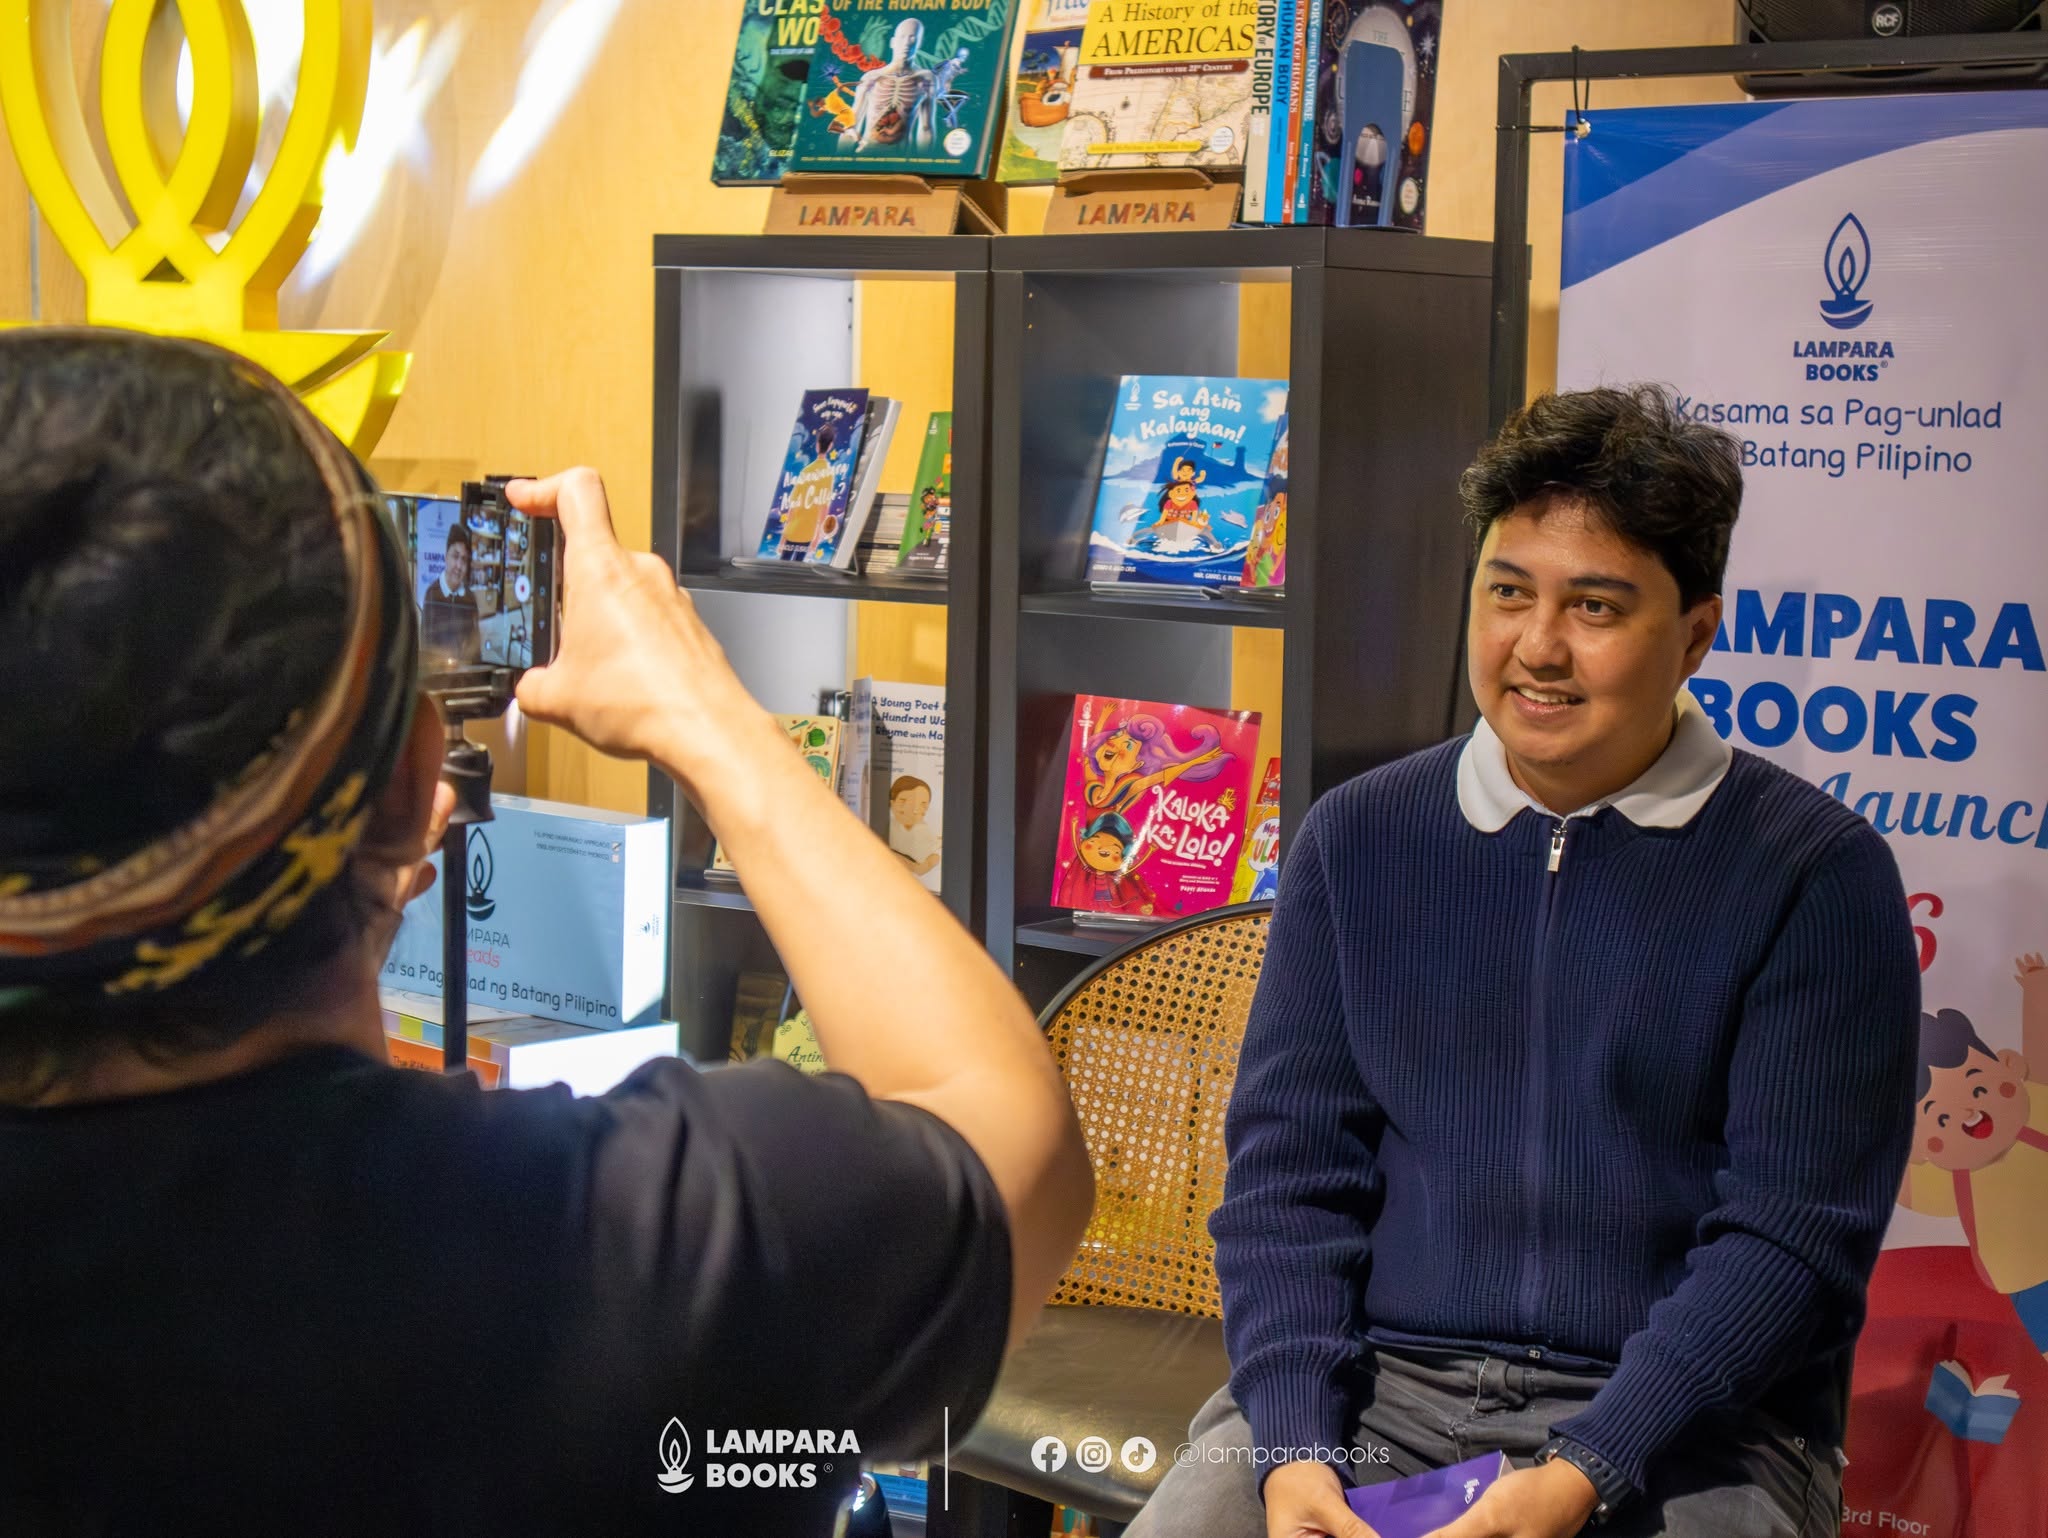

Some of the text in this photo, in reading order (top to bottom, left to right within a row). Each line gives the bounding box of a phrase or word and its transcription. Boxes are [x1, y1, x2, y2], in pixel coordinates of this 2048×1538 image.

[1099, 9, 1114, 23] A
[1123, 2, 1195, 29] History
[1201, 0, 1222, 18] of
[1229, 0, 1257, 16] the
[1278, 0, 1295, 59] HUMAN
[1875, 13, 1899, 28] RCF
[1091, 24, 1256, 58] AMERICAS
[1251, 48, 1274, 115] EUROPE
[1276, 64, 1291, 105] BODY
[798, 205, 916, 227] LAMPARA
[1077, 200, 1196, 226] LAMPARA
[1793, 341, 1895, 358] LAMPARA
[1152, 386, 1243, 413] Sa Atin
[1179, 403, 1211, 422] ang
[1139, 415, 1247, 444] Kalayaan!
[1675, 396, 2002, 436] Kasama sa Pag-unlad
[1741, 440, 1973, 480] Batang Pilipino
[880, 696, 912, 711] Young
[915, 699, 940, 711] Poet
[882, 711, 927, 724] Hundred
[1688, 677, 1979, 763] BOOKS
[1819, 772, 2048, 850] aunc
[399, 964, 415, 978] sa
[489, 981, 507, 1000] ng
[511, 982, 561, 1011] Batang
[564, 992, 617, 1019] Pilipino
[1841, 1505, 1931, 1537] 3rd Floor
